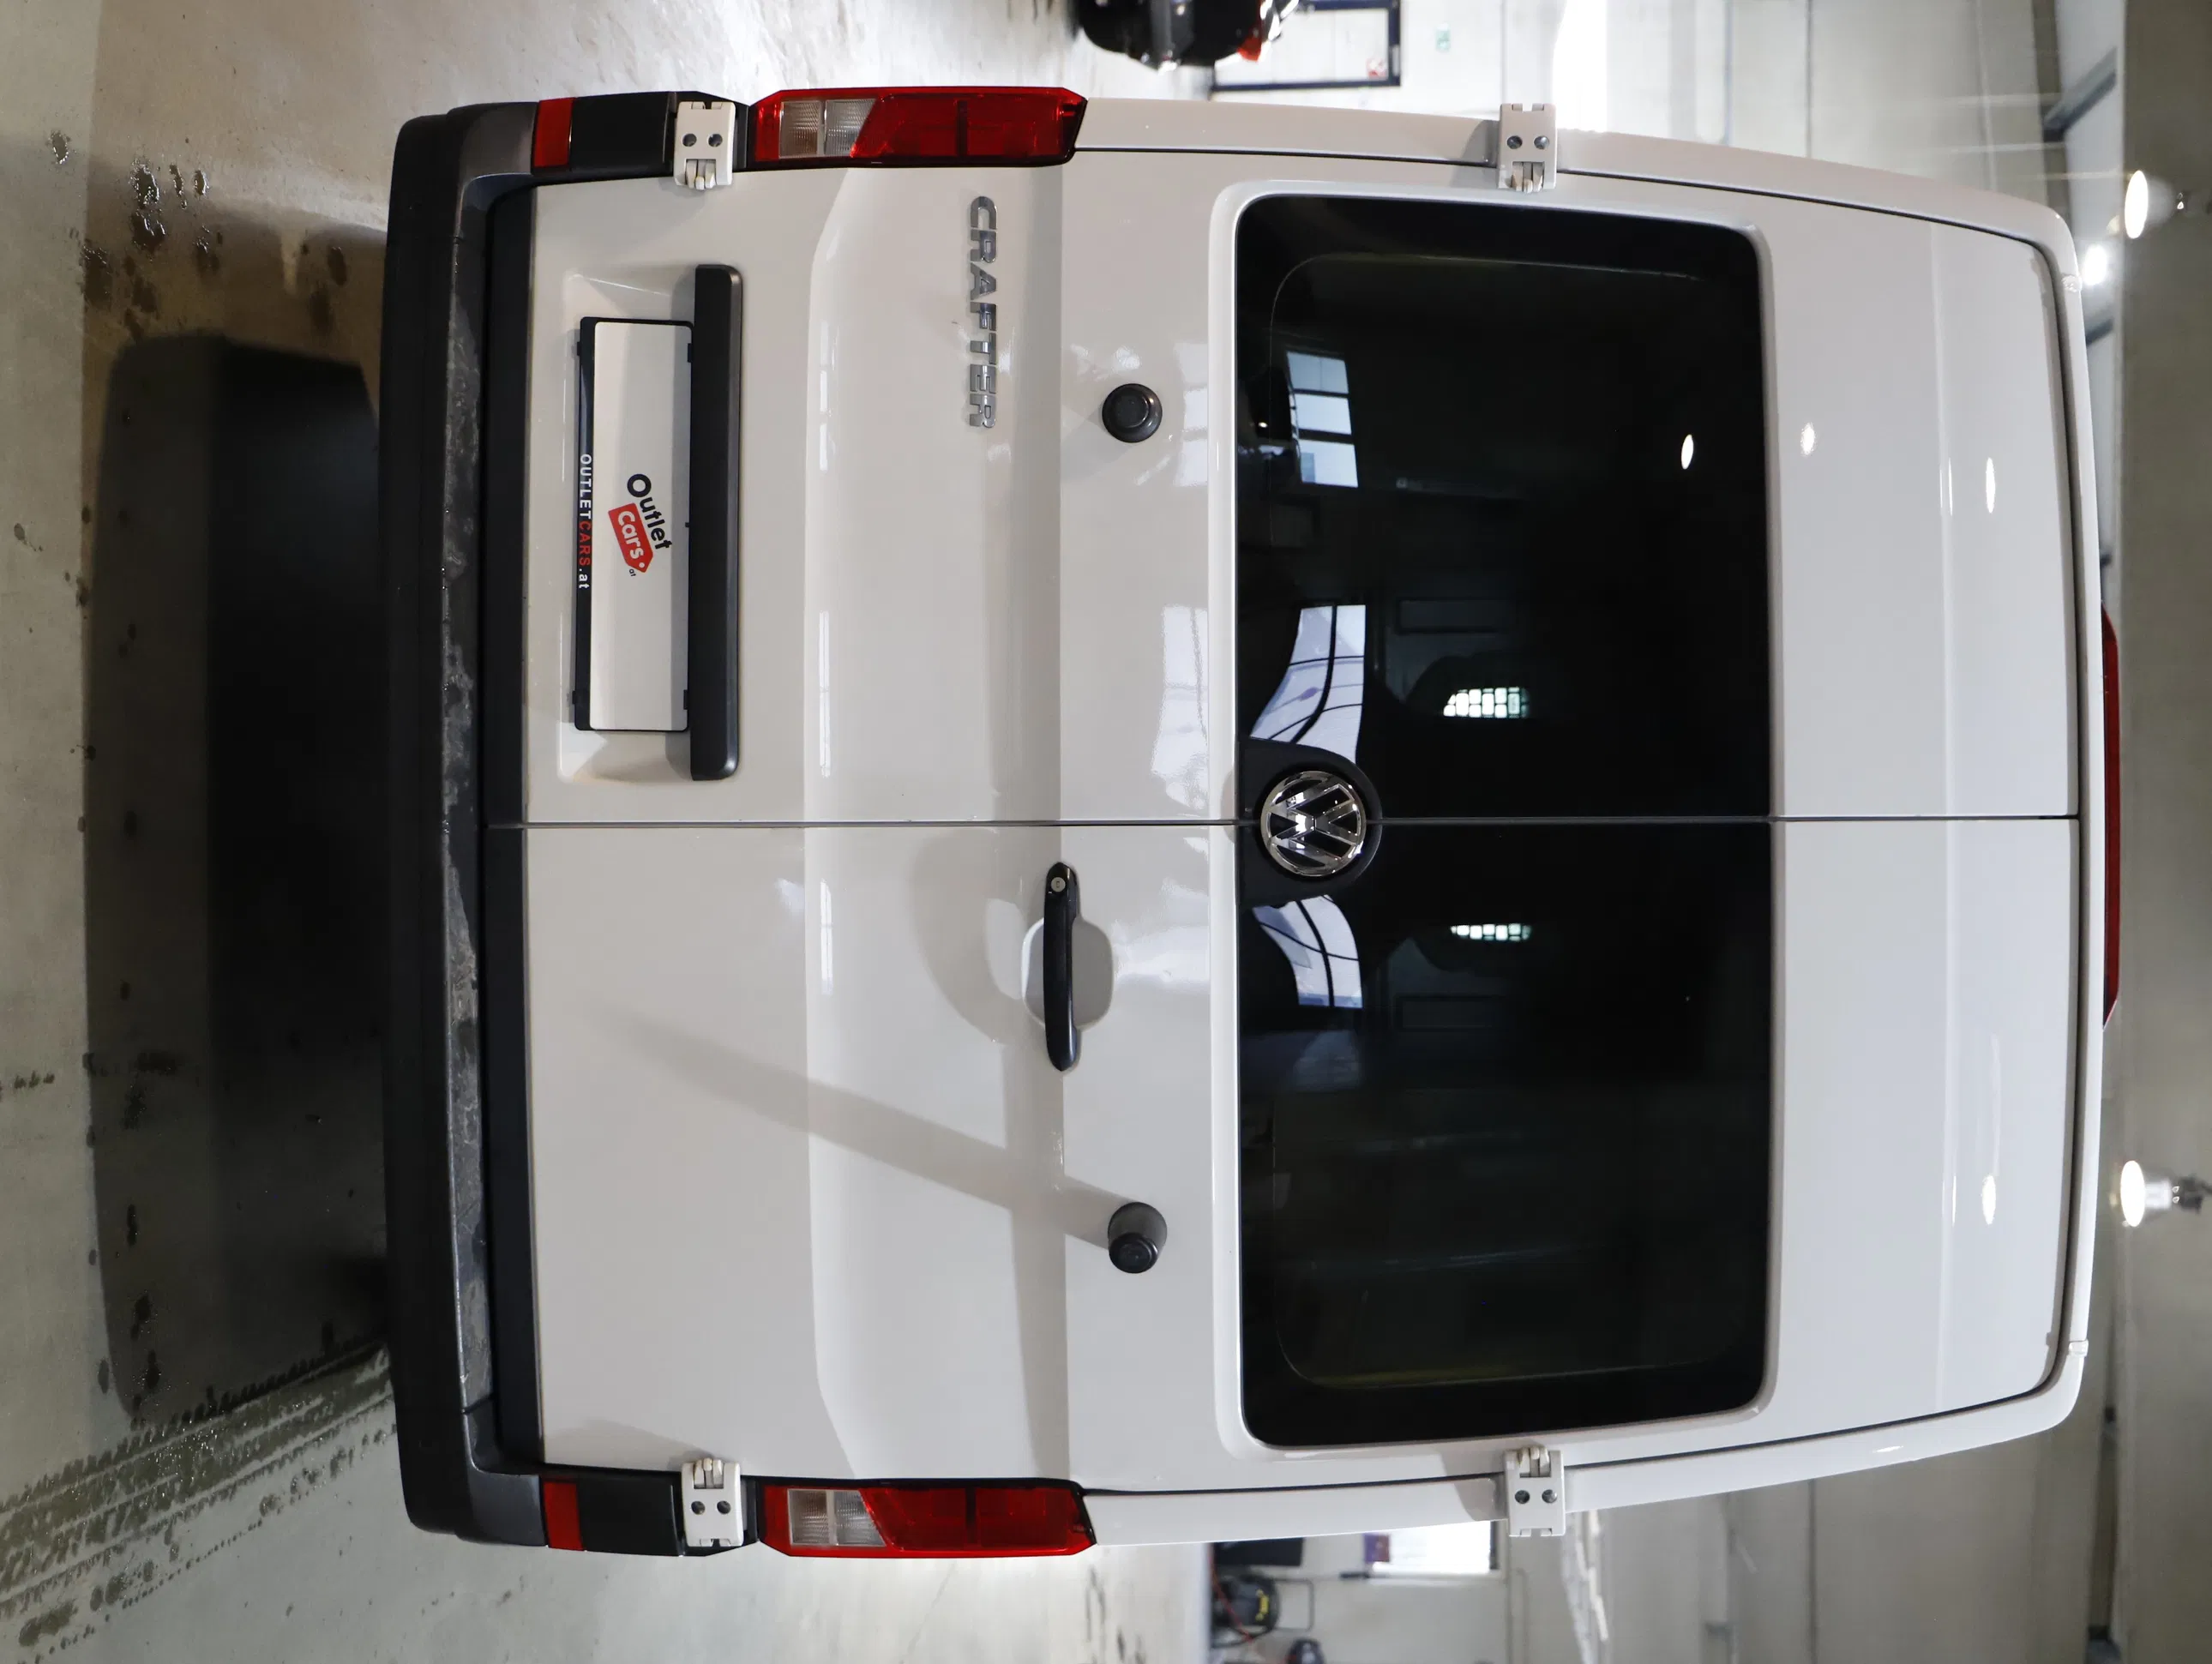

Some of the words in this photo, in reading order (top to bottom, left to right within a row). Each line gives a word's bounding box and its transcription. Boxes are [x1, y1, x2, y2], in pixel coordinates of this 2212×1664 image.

[970, 195, 997, 429] CRAFTER
[627, 473, 672, 550] Outlet
[1260, 770, 1367, 877] VW
